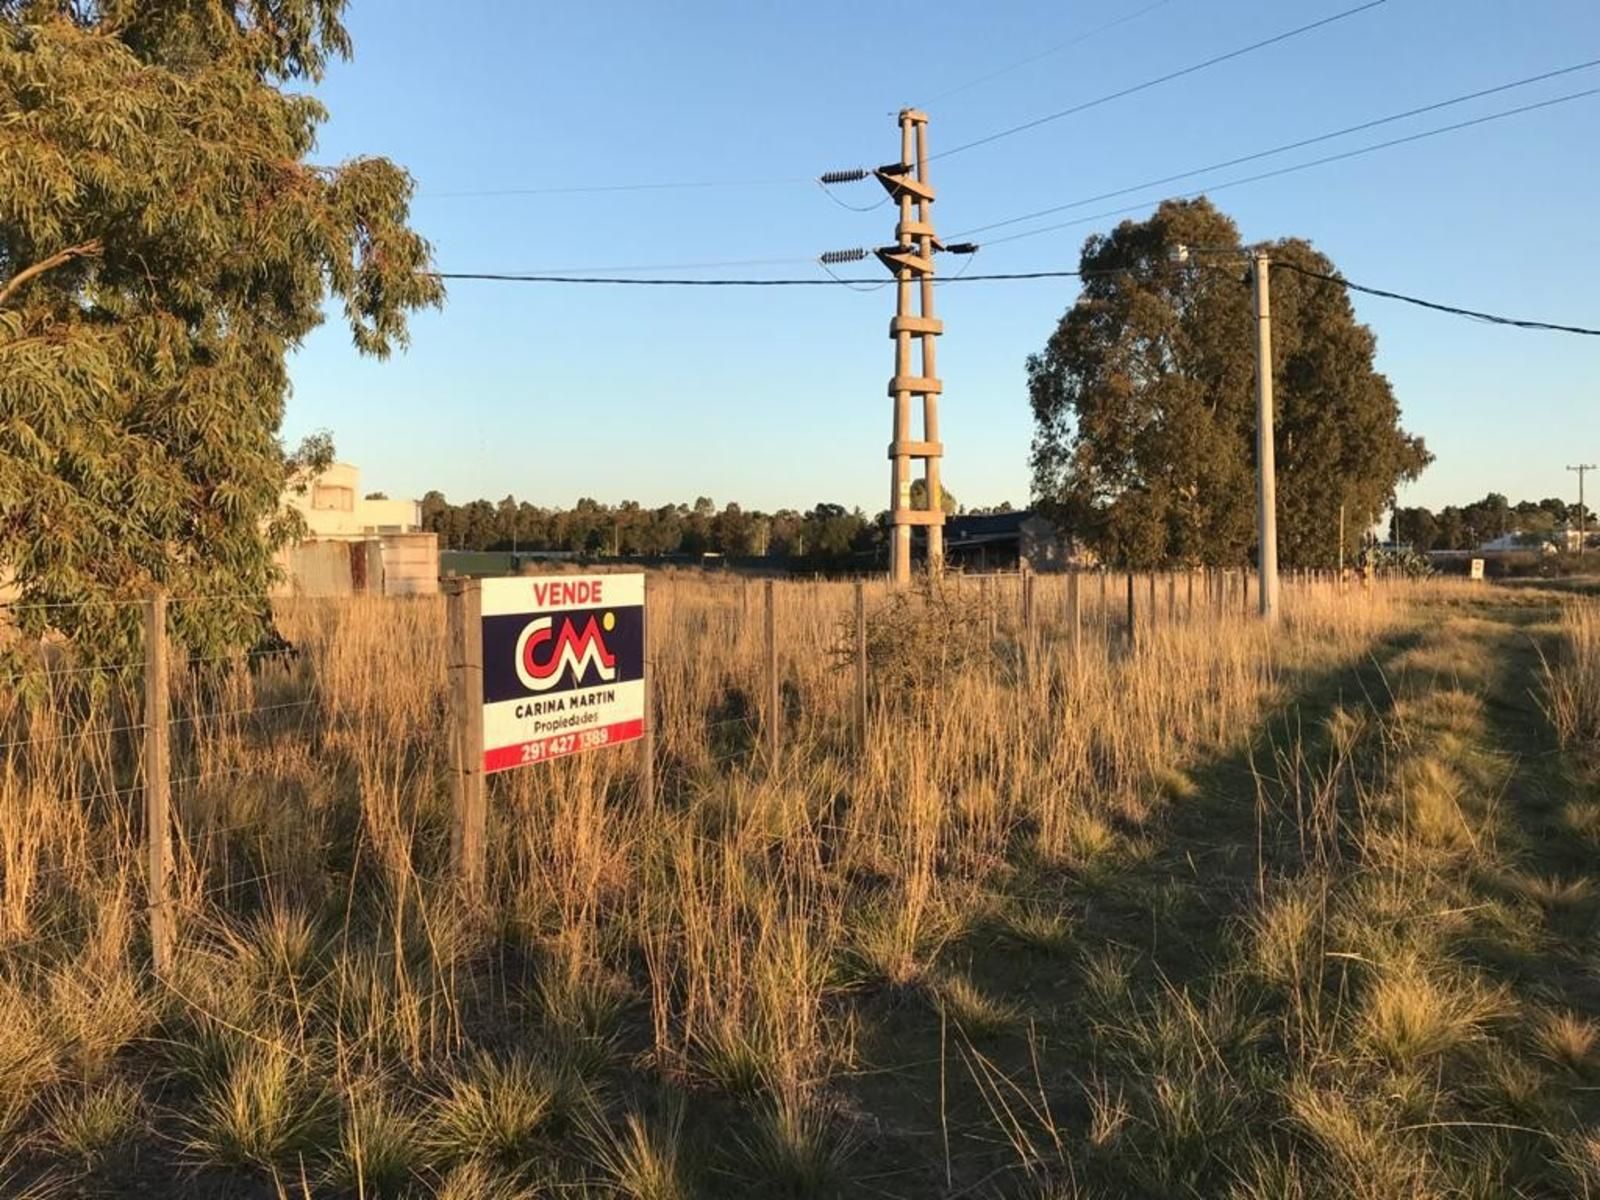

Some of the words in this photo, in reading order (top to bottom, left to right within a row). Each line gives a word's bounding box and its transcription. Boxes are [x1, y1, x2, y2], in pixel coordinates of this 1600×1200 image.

[533, 581, 603, 607] VENDE
[515, 615, 616, 691] CM
[515, 698, 566, 719] CARINA
[569, 690, 616, 709] MARTIN
[533, 711, 599, 734] Propiedades
[520, 742, 547, 762] 291
[548, 734, 576, 754] 427
